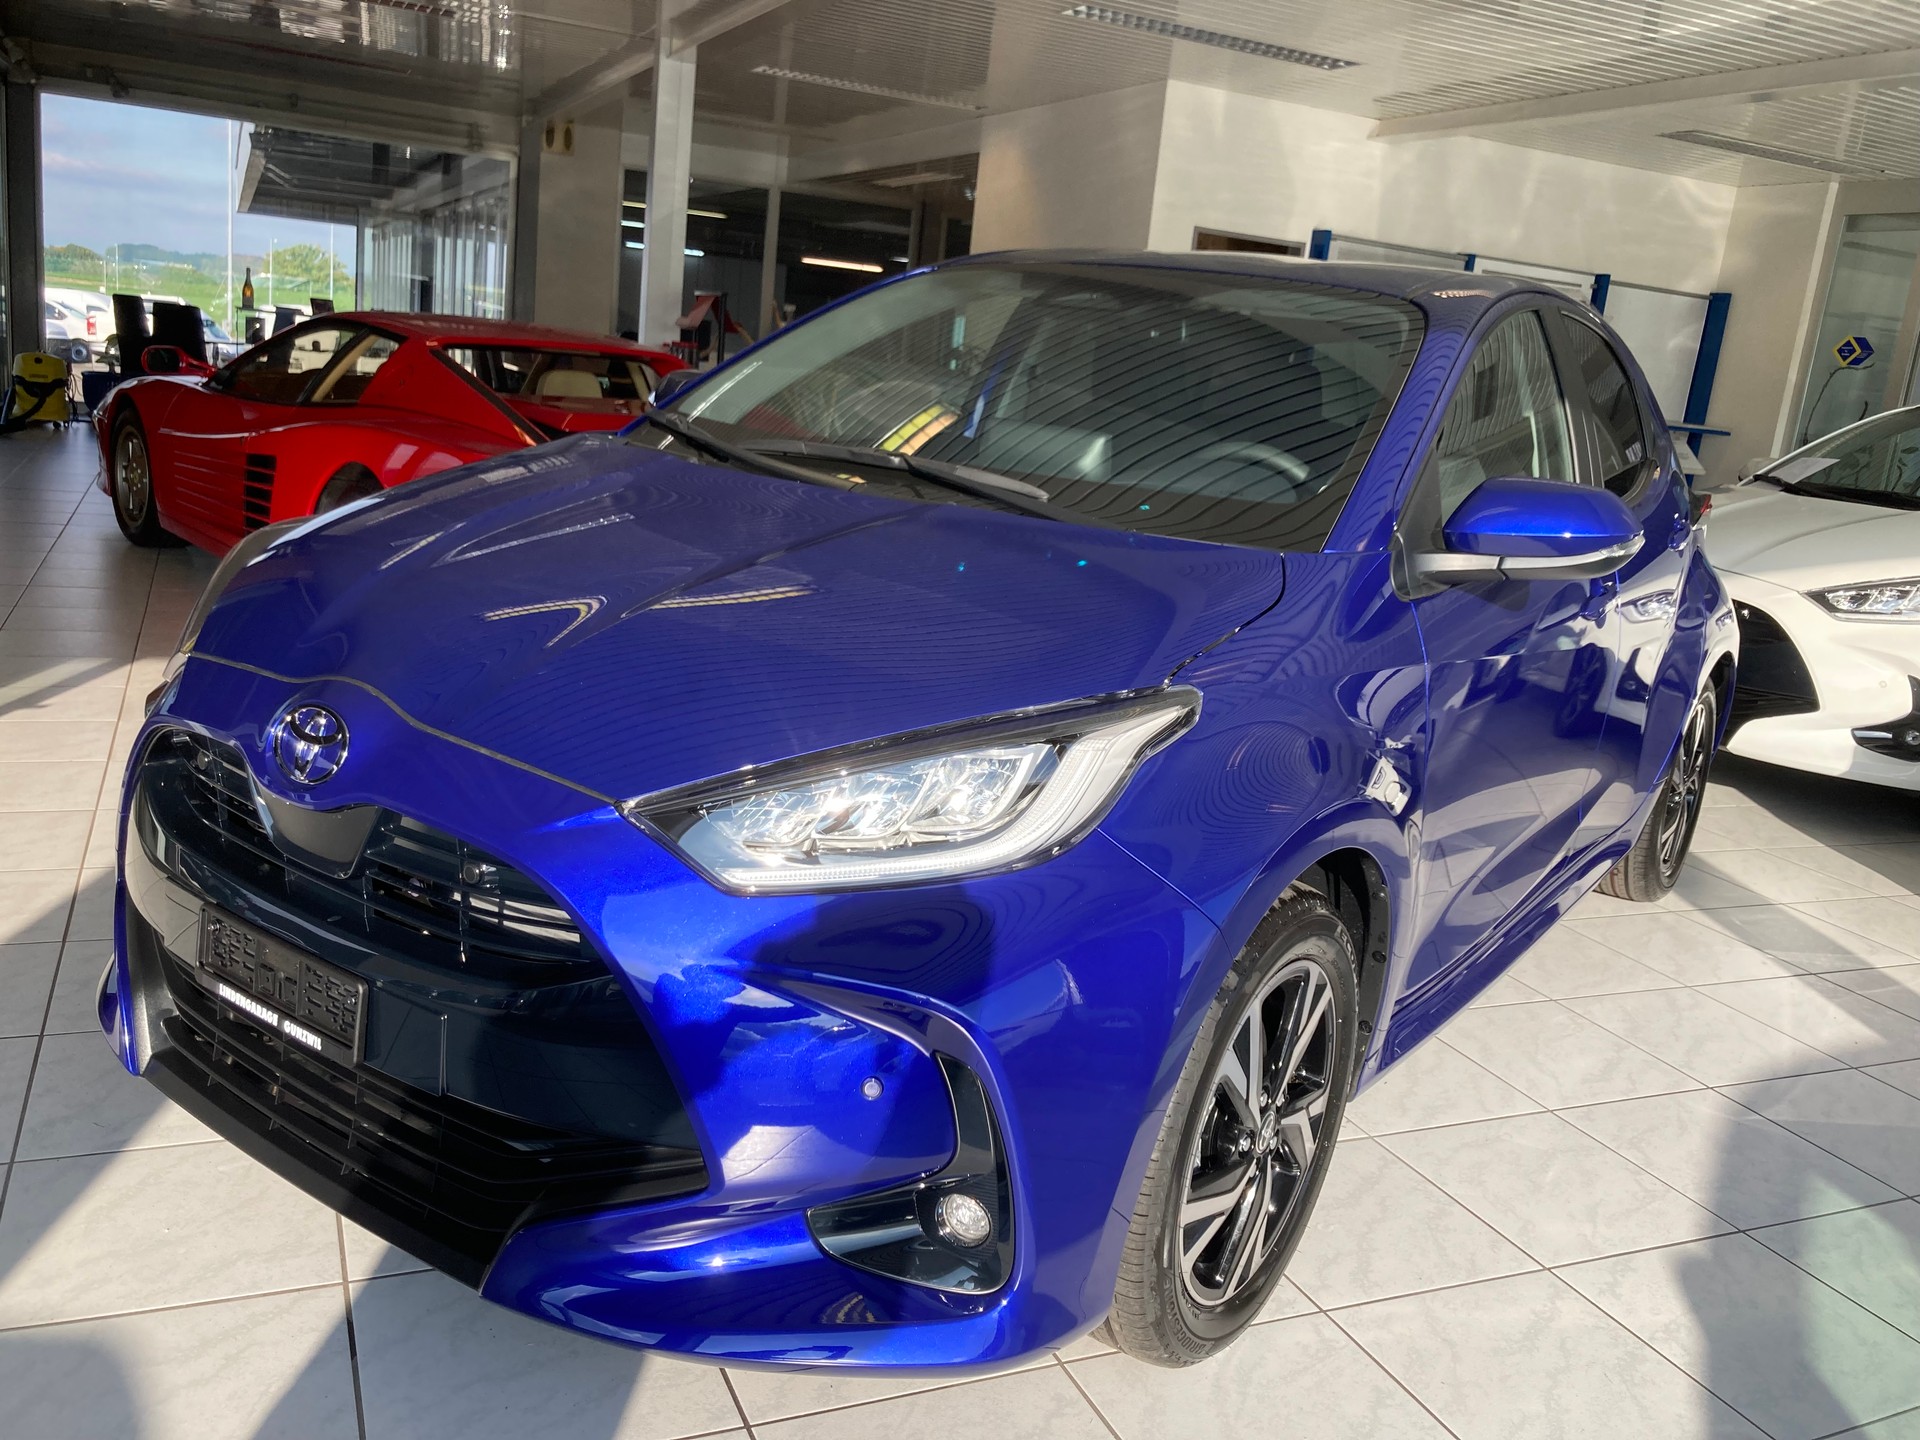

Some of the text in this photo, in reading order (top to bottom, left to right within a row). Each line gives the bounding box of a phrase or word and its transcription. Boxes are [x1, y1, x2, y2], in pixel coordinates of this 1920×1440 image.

[219, 983, 322, 1051] LINDENGARAGE GUNZWIL
[1163, 1279, 1207, 1355] BRIDGESTONE
